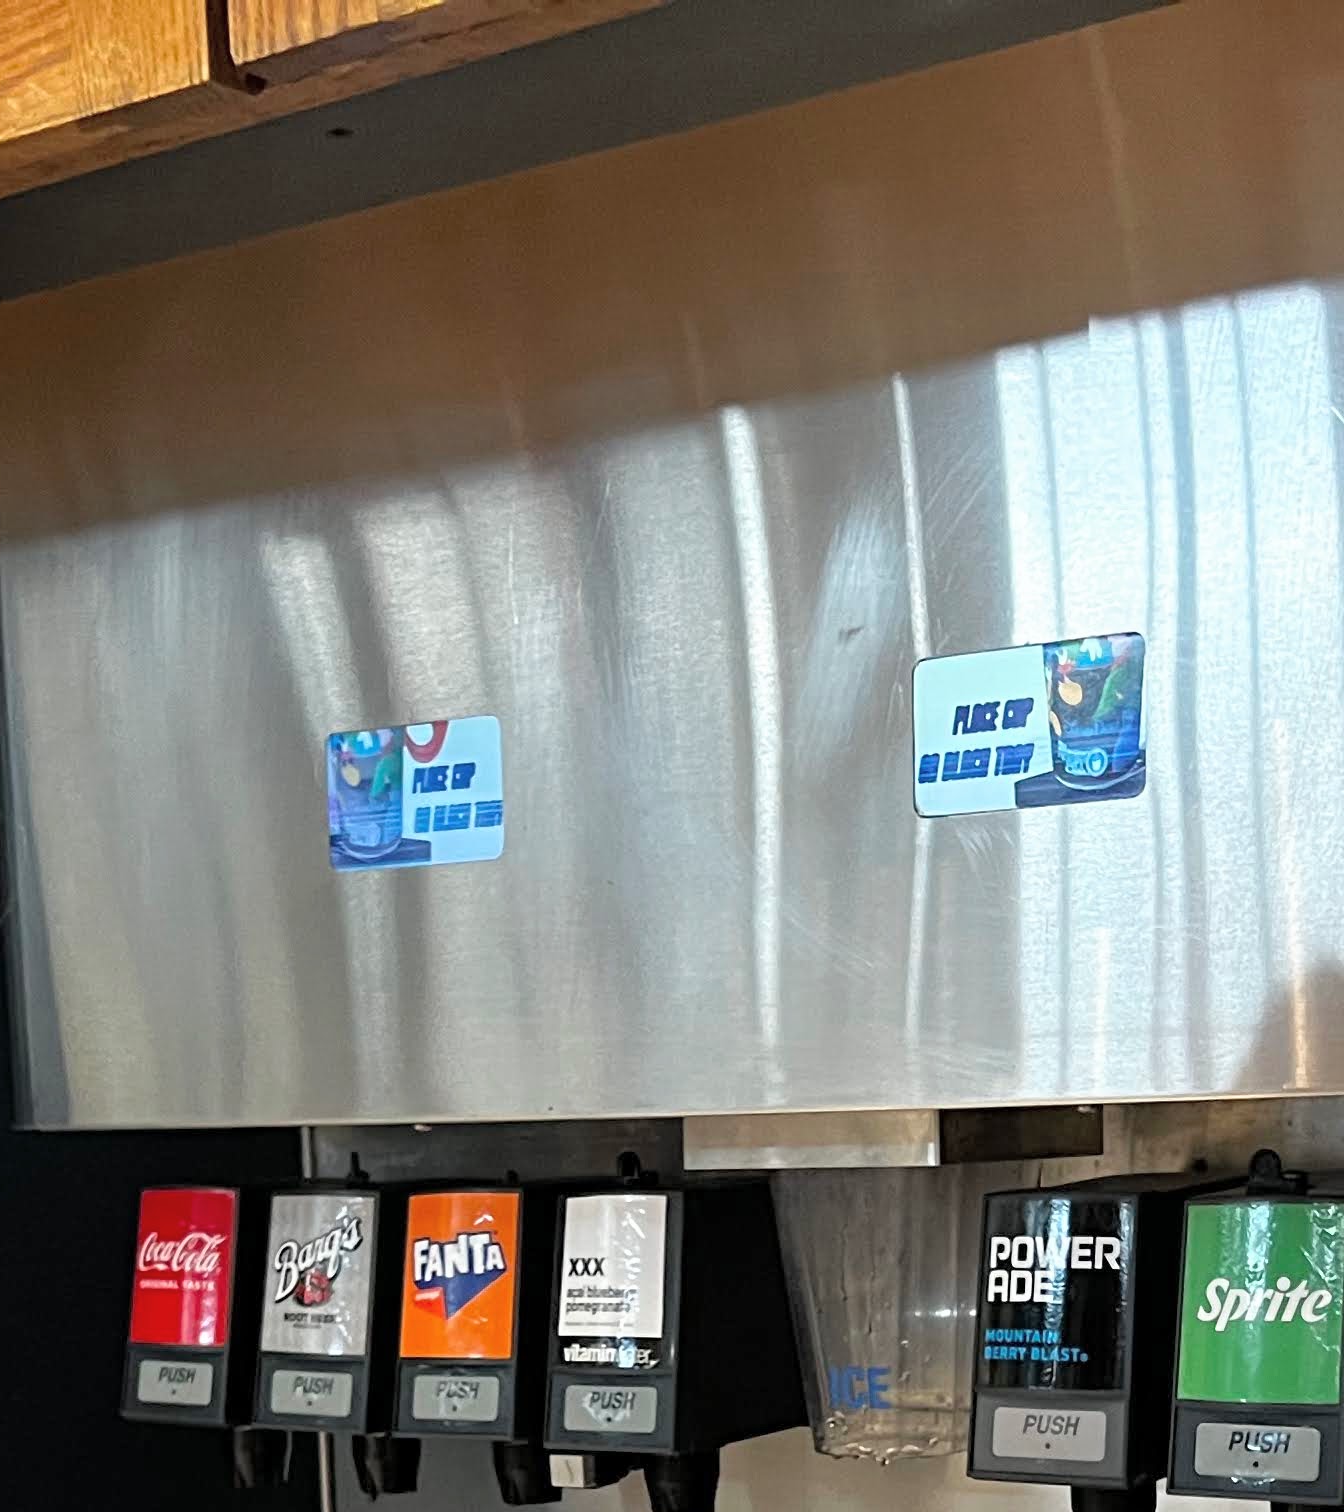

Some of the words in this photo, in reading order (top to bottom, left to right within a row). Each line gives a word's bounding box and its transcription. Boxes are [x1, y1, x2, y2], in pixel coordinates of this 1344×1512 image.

[413, 1231, 506, 1282] FANTA
[989, 1236, 1121, 1270] POWER
[987, 1269, 1061, 1304] ADE
[1197, 1276, 1333, 1332] Sprite
[158, 1367, 196, 1384] PUSH
[293, 1376, 335, 1395] PUSH
[828, 1367, 892, 1410] ICE
[589, 1391, 636, 1410] PUSH
[1022, 1414, 1081, 1437] PUSH
[1228, 1430, 1292, 1455] PUSH
